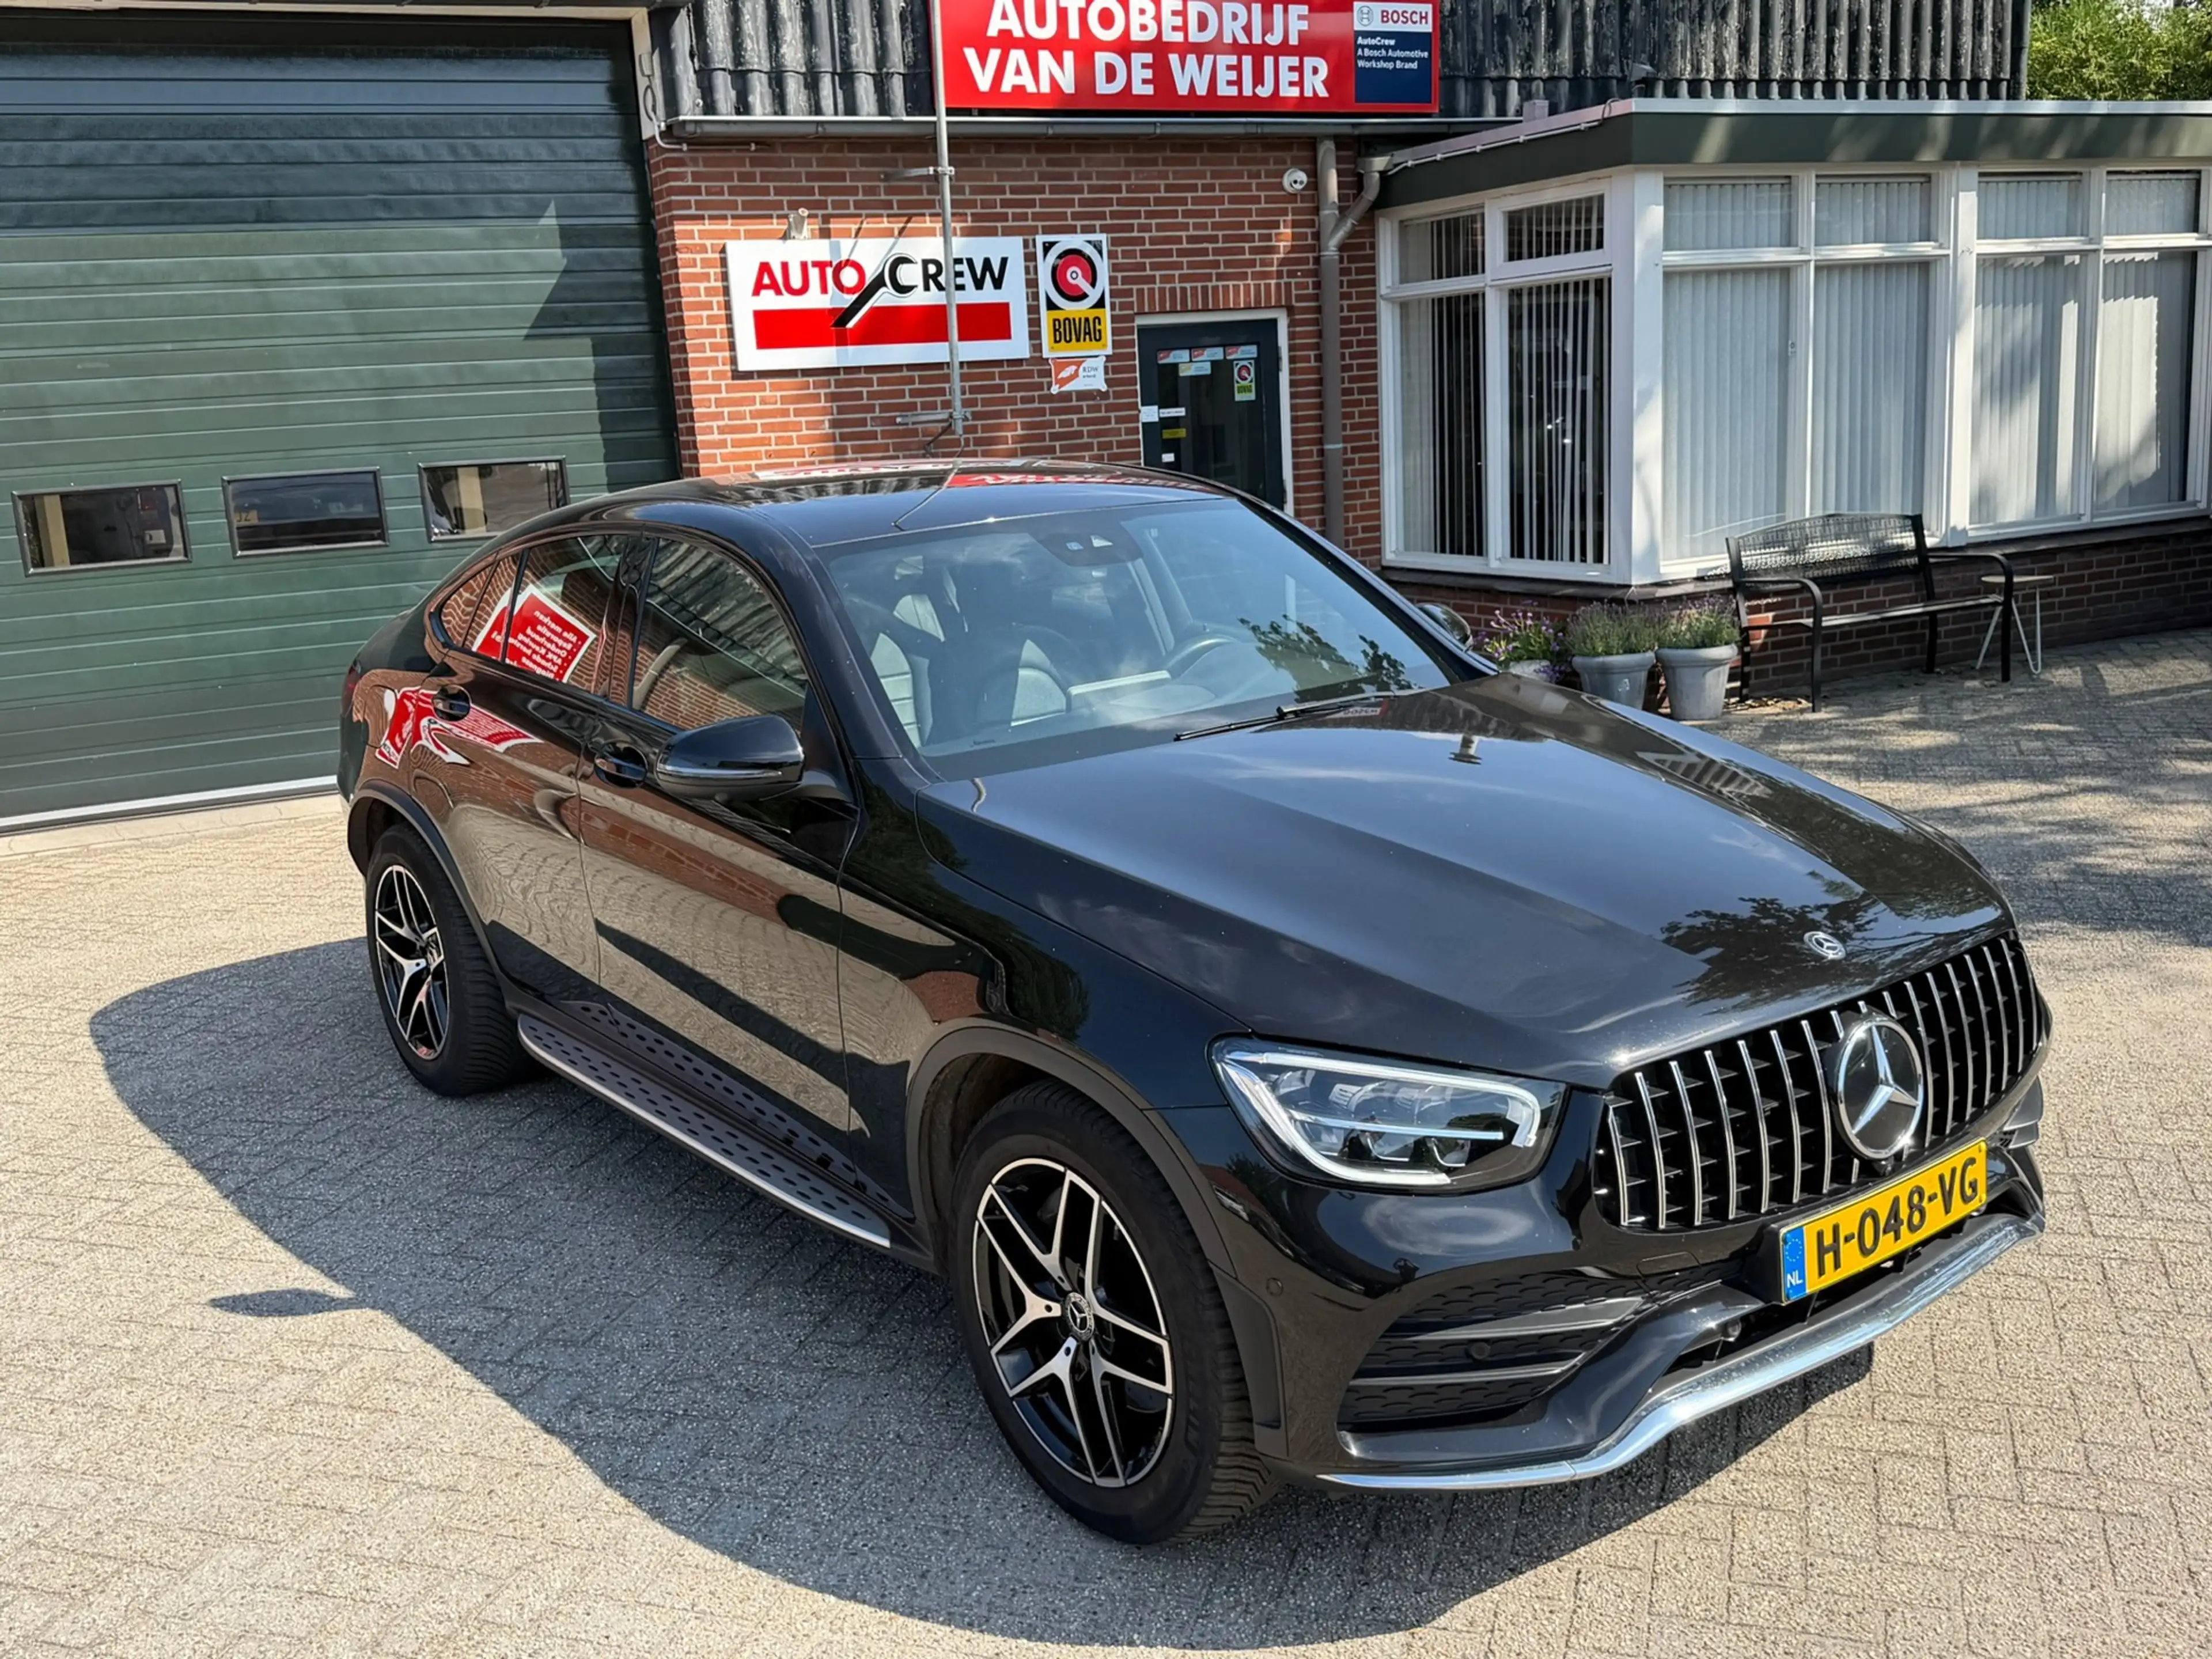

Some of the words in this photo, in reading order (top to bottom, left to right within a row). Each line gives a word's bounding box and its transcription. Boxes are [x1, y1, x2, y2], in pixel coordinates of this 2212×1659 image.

[986, 0, 1309, 46] AUTOBEDRIJF
[1380, 9, 1429, 25] BOSCH
[1357, 36, 1396, 46] AutoCrew
[1357, 48, 1363, 56] A
[1363, 48, 1387, 57] Bosch
[1387, 49, 1429, 58] Automotive
[963, 47, 1075, 94] VAN
[1094, 51, 1154, 96] DE
[1168, 53, 1330, 98] WEIJER
[1357, 59, 1395, 70] Workshop
[1396, 60, 1418, 69] Brand
[1052, 316, 1102, 344] BOVAG
[1816, 1156, 1979, 1279] H-048-VG
[1786, 1270, 1804, 1289] NL
